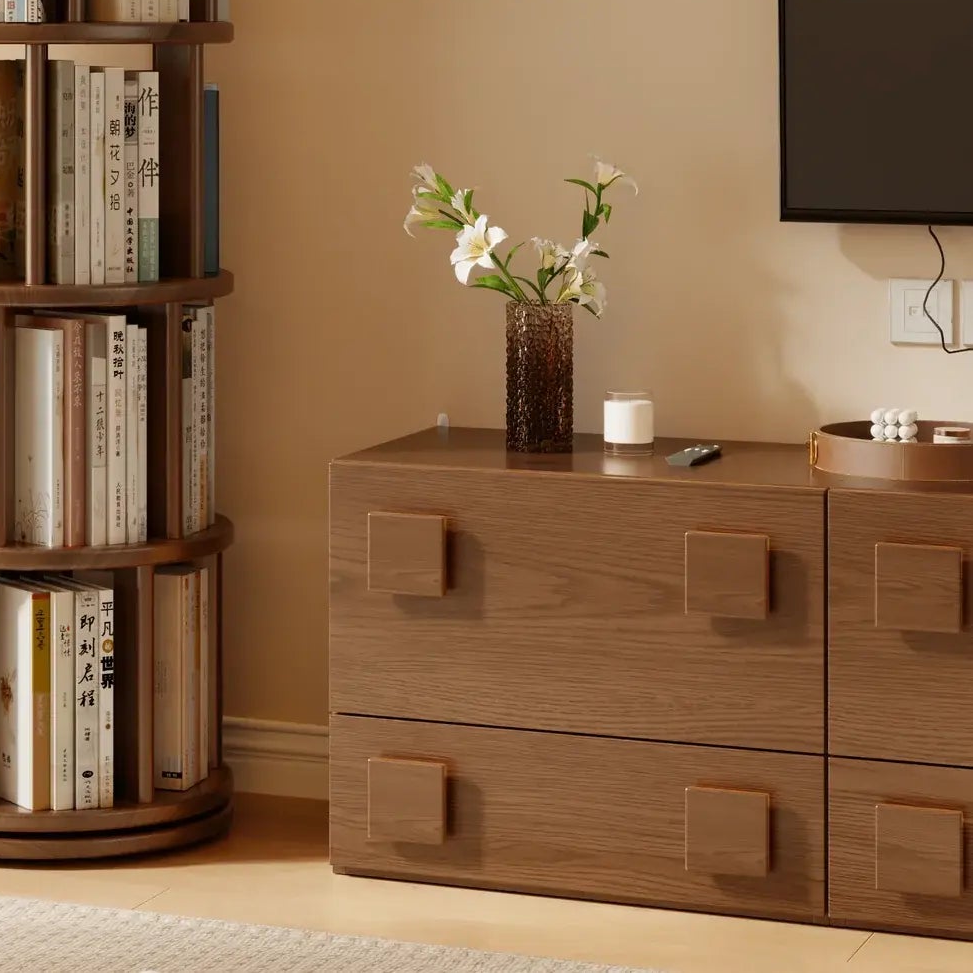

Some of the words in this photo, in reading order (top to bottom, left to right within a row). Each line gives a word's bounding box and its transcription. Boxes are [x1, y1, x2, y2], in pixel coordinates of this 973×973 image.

[124, 101, 136, 138] 海的梦
[109, 119, 120, 211] 朝花夕拾
[126, 207, 134, 273] 中国文学出版社
[113, 330, 125, 380] 晚秋拾叶
[79, 614, 96, 708] 即刻启程
